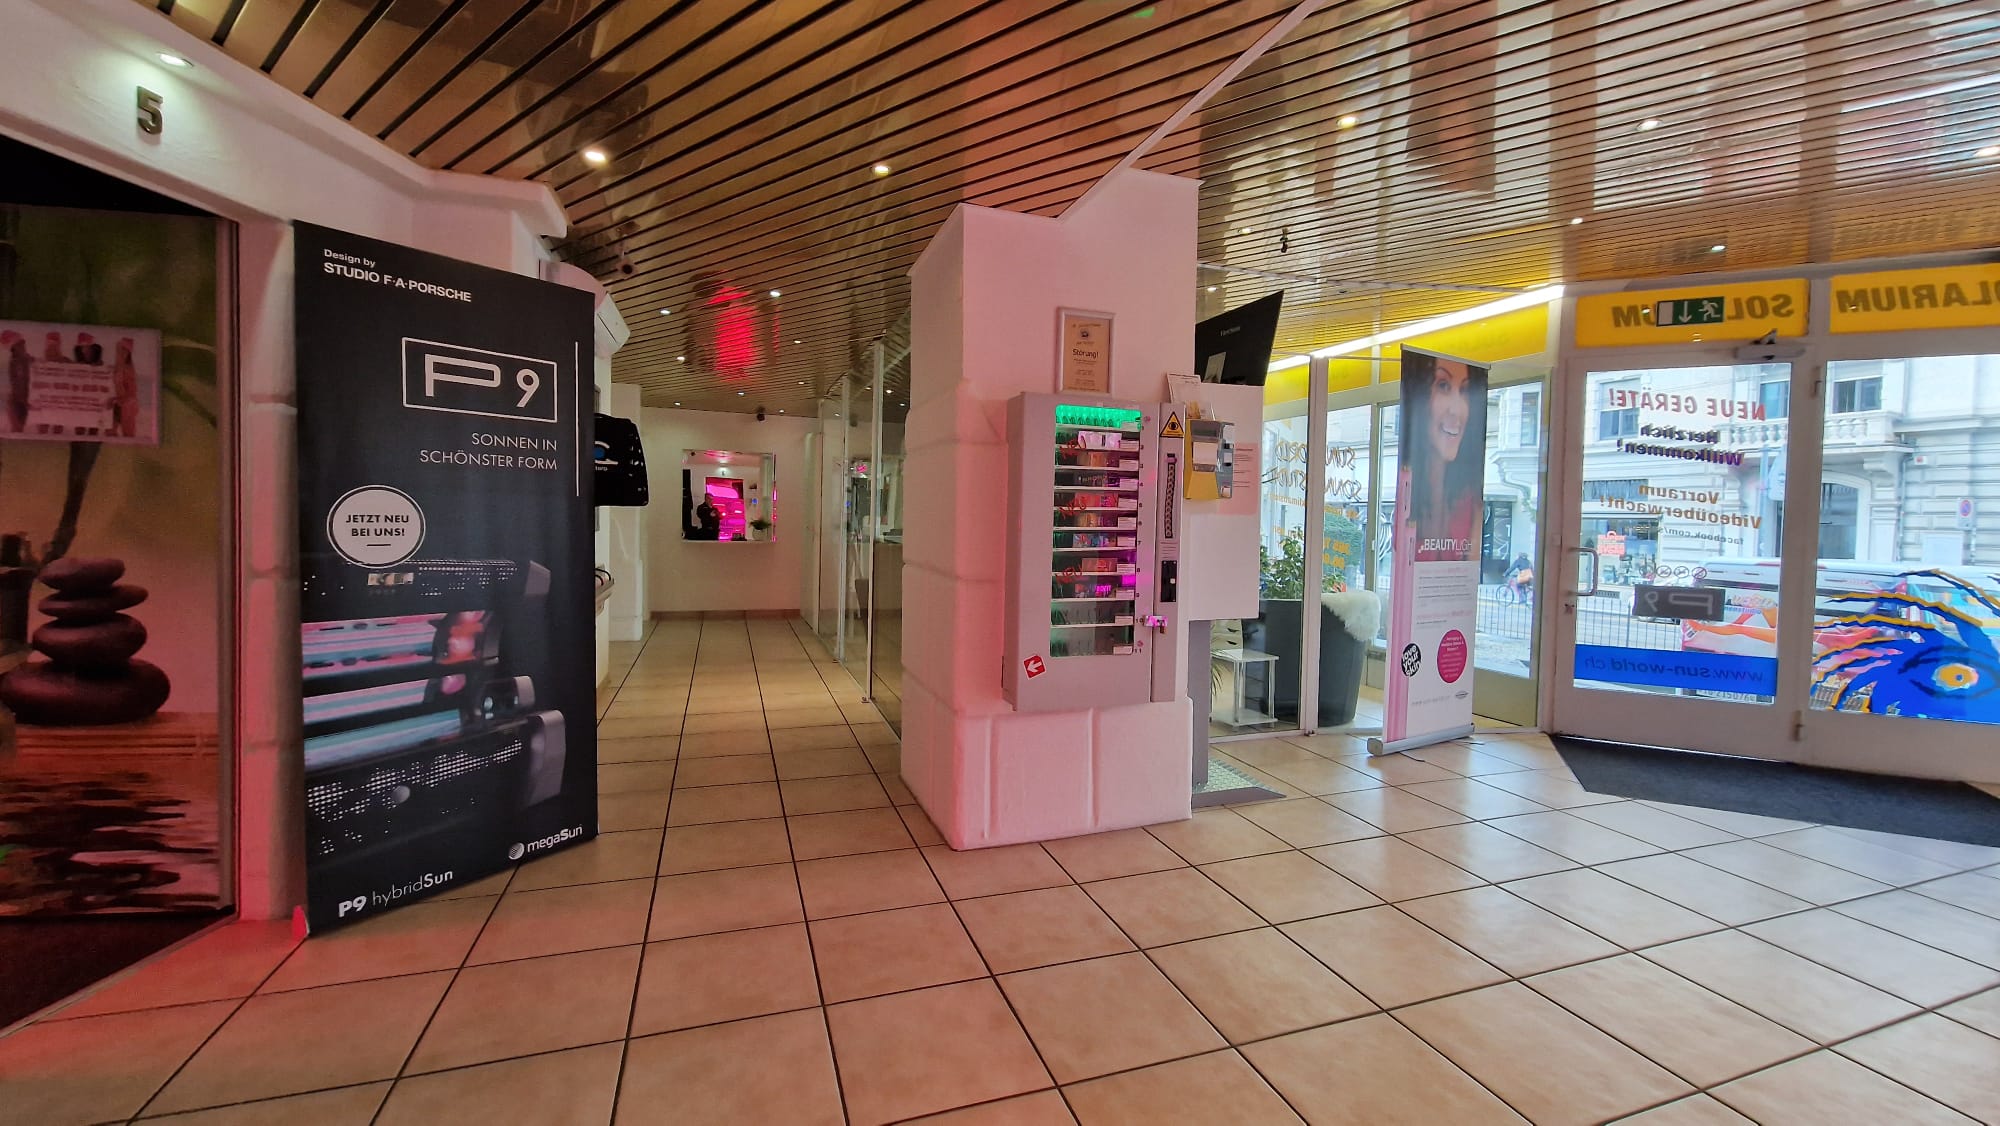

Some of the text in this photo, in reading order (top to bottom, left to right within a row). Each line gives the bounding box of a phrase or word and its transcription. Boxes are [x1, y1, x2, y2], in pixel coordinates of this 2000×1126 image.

[137, 86, 163, 134] 5
[323, 248, 376, 269] Design by
[323, 262, 380, 284] STUDIO
[471, 432, 557, 451] SONNEN IN
[419, 449, 558, 471] SCHÖNSTER FORM
[345, 513, 410, 524] JETZT NEU
[351, 527, 406, 538] BEI UNS!
[527, 825, 583, 853] megaSun
[338, 869, 453, 918] P9 hybridSun
